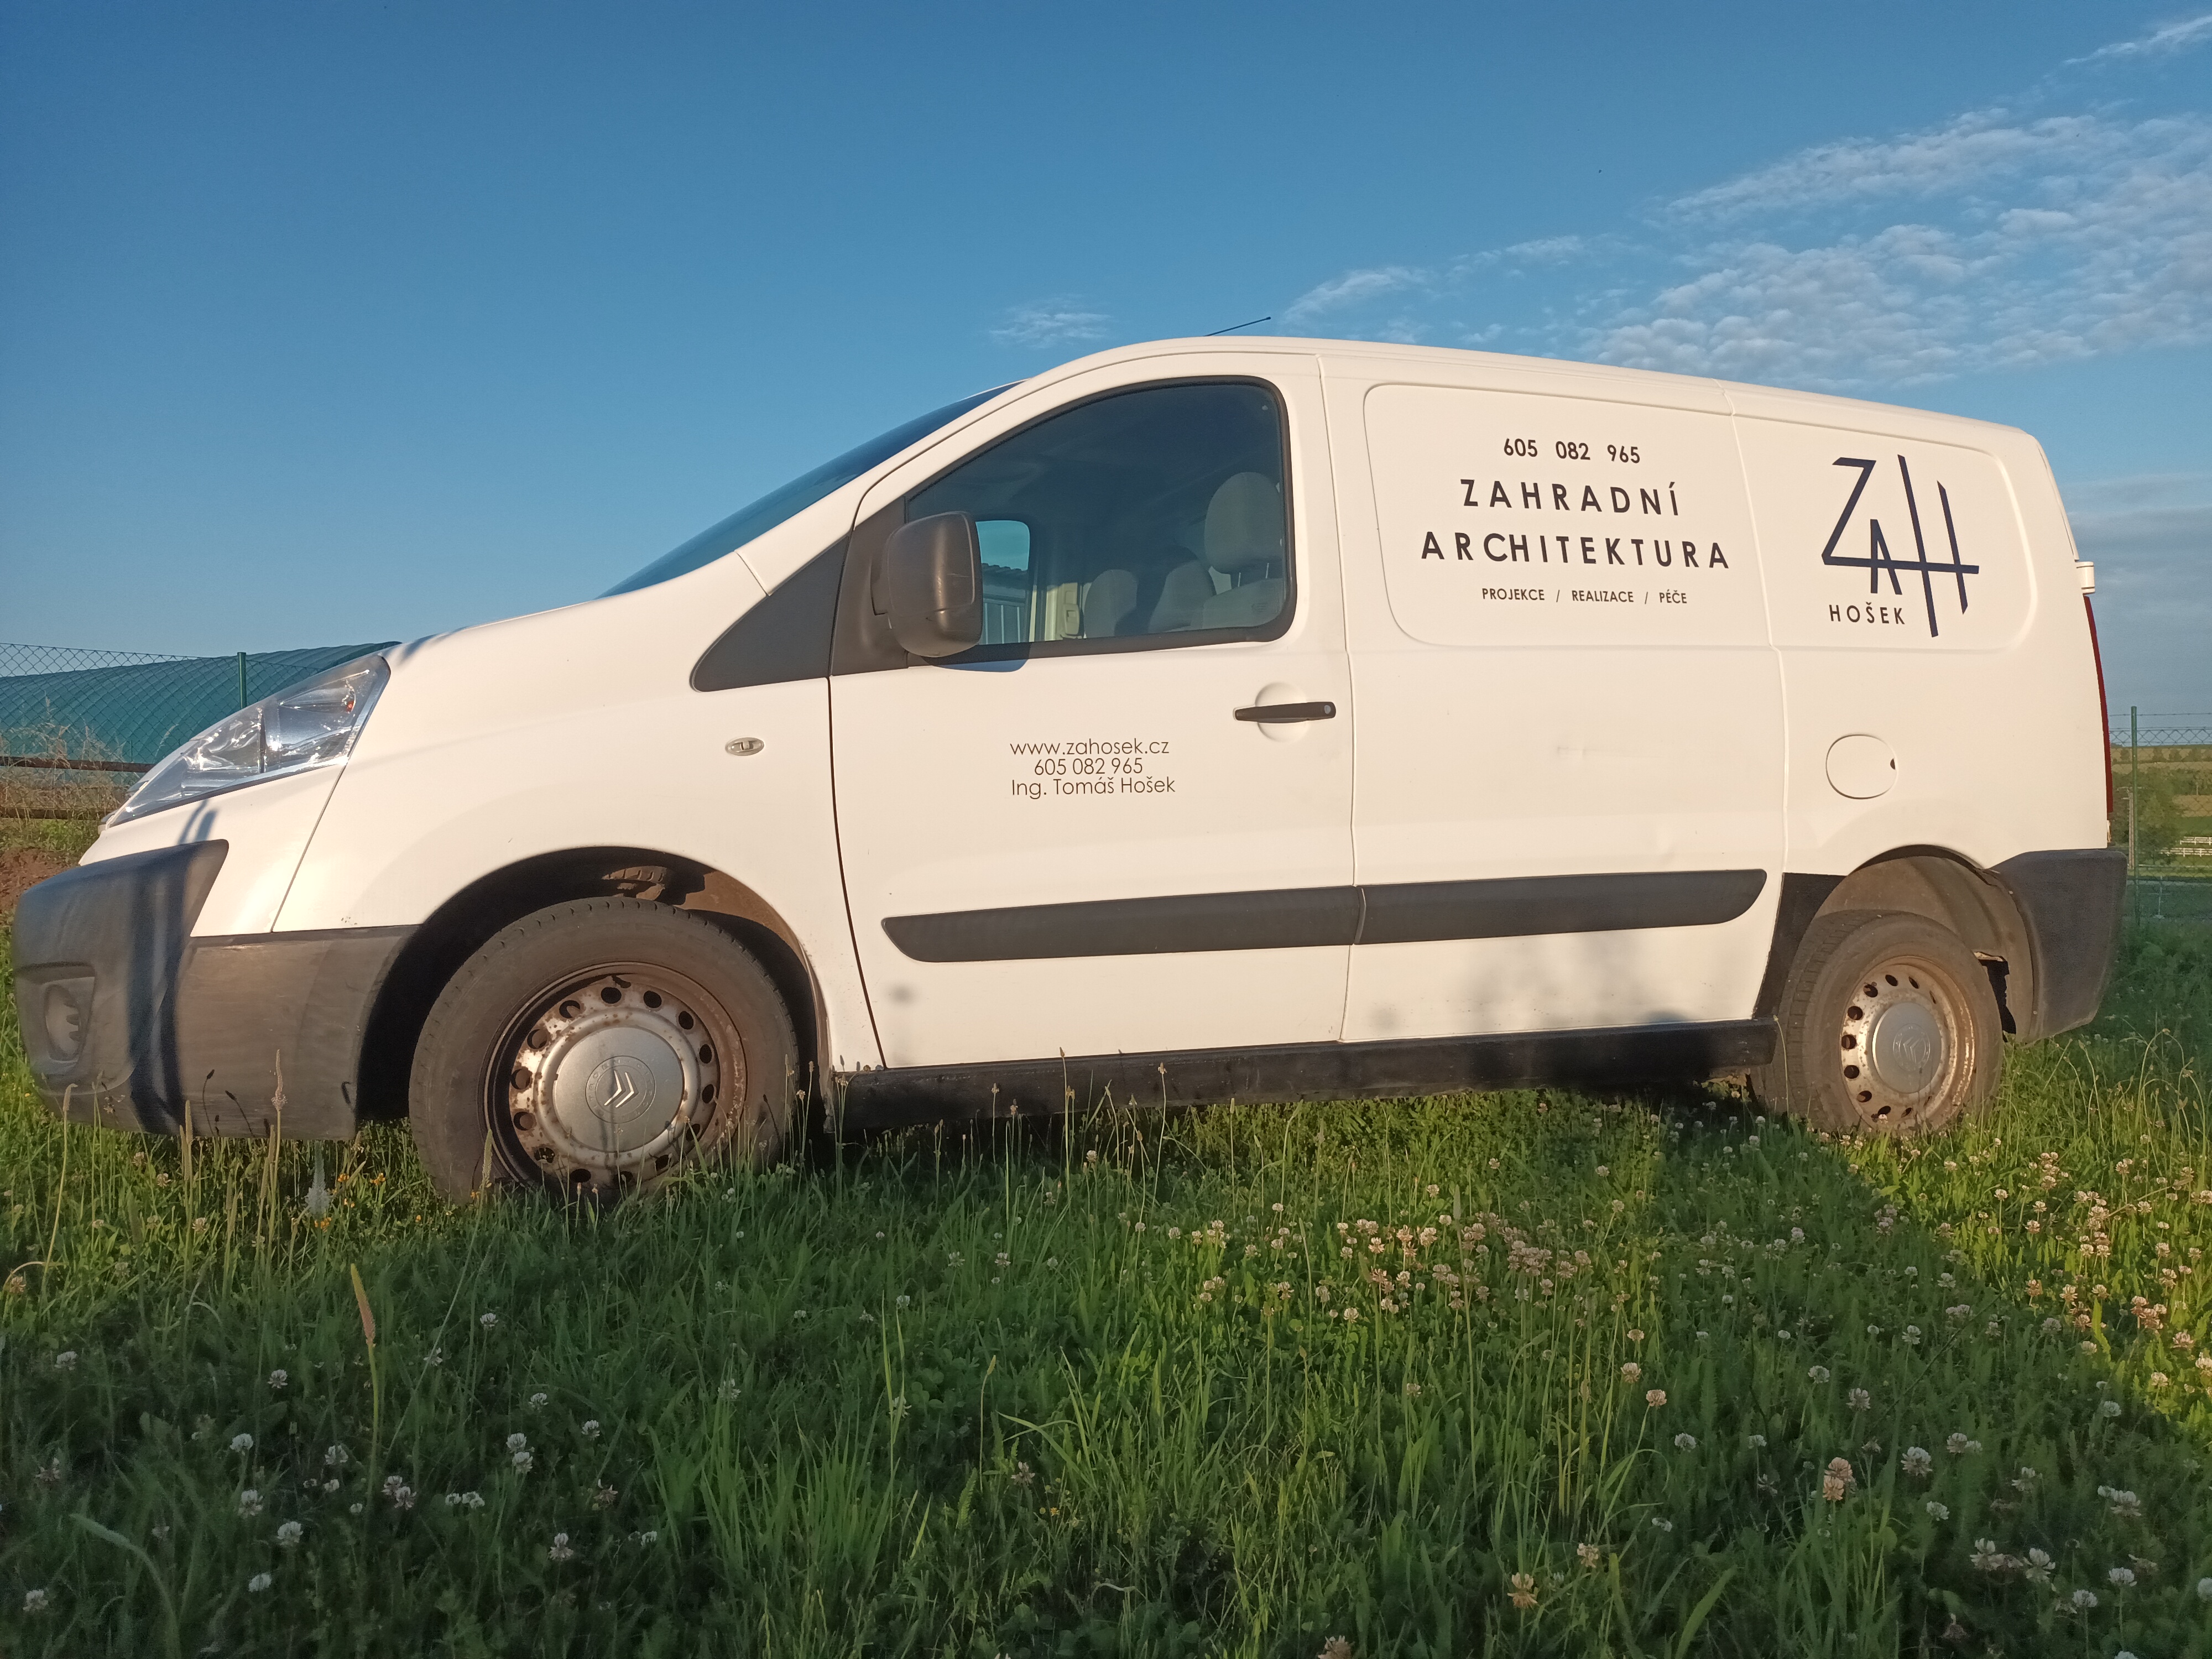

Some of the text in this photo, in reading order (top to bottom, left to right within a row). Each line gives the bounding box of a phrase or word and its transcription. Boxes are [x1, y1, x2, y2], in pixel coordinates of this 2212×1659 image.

[1504, 438, 1640, 464] 605 082 965
[1460, 479, 1678, 516] ZAHRADNÍ
[1421, 531, 1729, 569] ARCHITEKTURA
[1482, 588, 1687, 604] PROJEKCE / REALIZACE / PÉČE
[1829, 601, 1905, 625] HOŠEK
[1010, 738, 1170, 755] www.zahosek.cz
[1034, 757, 1142, 776] 605 082 965
[1012, 776, 1175, 800] Ing. Tomáš Hošek
